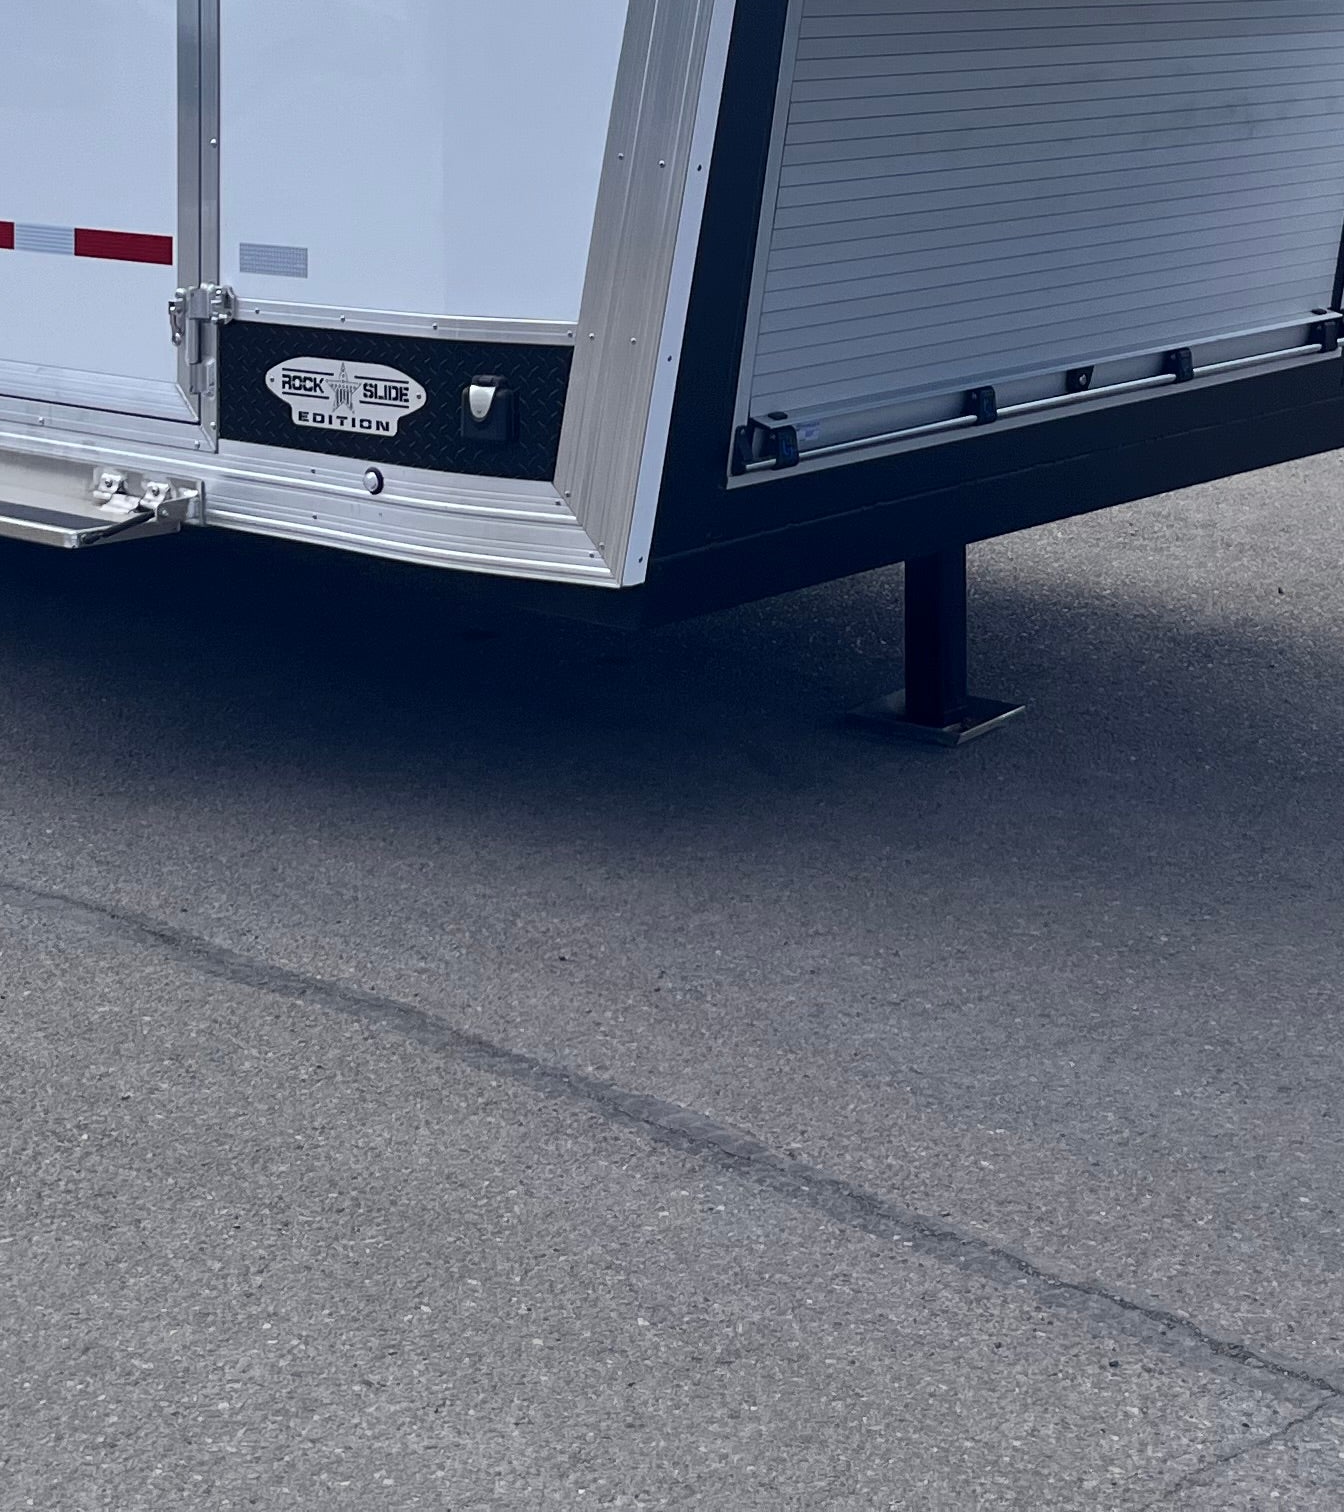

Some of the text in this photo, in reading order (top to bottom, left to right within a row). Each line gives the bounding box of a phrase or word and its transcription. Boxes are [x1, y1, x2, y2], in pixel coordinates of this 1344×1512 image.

[282, 374, 409, 402] ROCK SLIDE
[298, 411, 389, 431] EDITION
